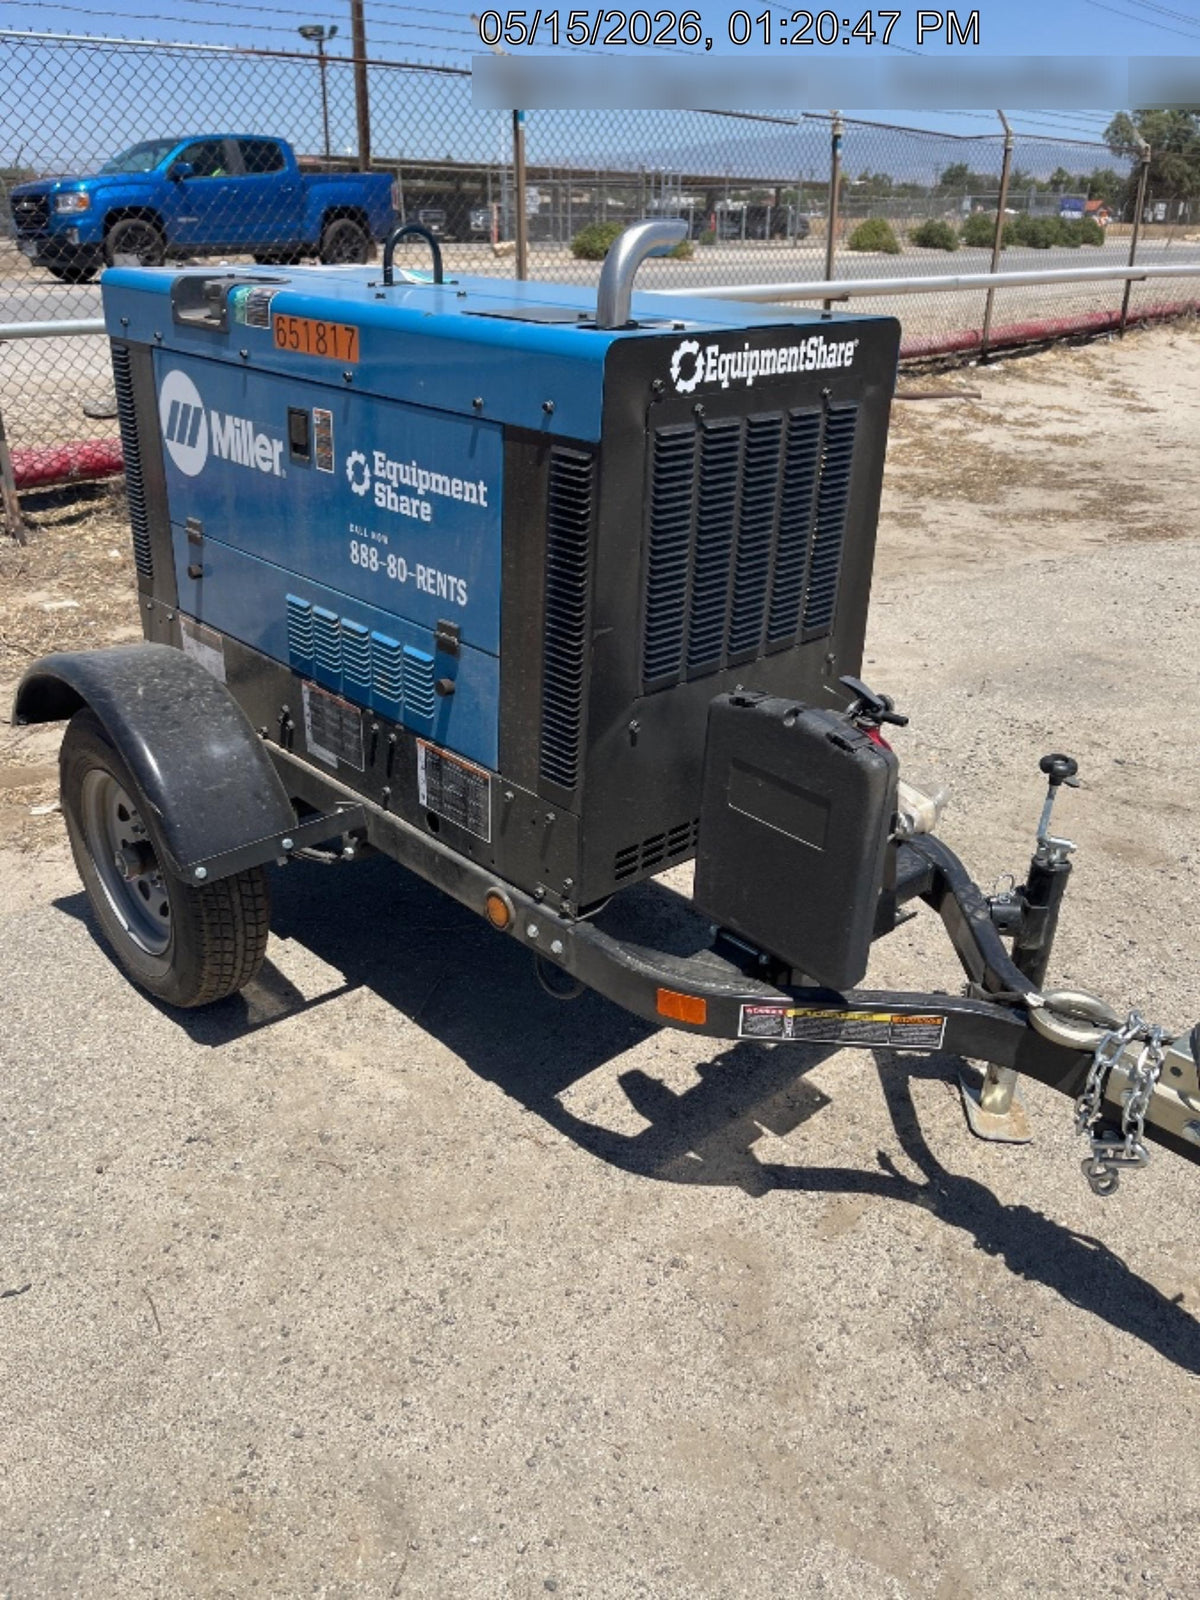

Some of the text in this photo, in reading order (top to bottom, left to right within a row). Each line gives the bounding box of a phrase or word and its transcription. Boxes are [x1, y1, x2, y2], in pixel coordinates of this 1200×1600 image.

[276, 316, 356, 360] 651817
[373, 450, 488, 508] Equipment
[374, 481, 433, 522] Share
[350, 540, 469, 607] 888-80-RENTS
